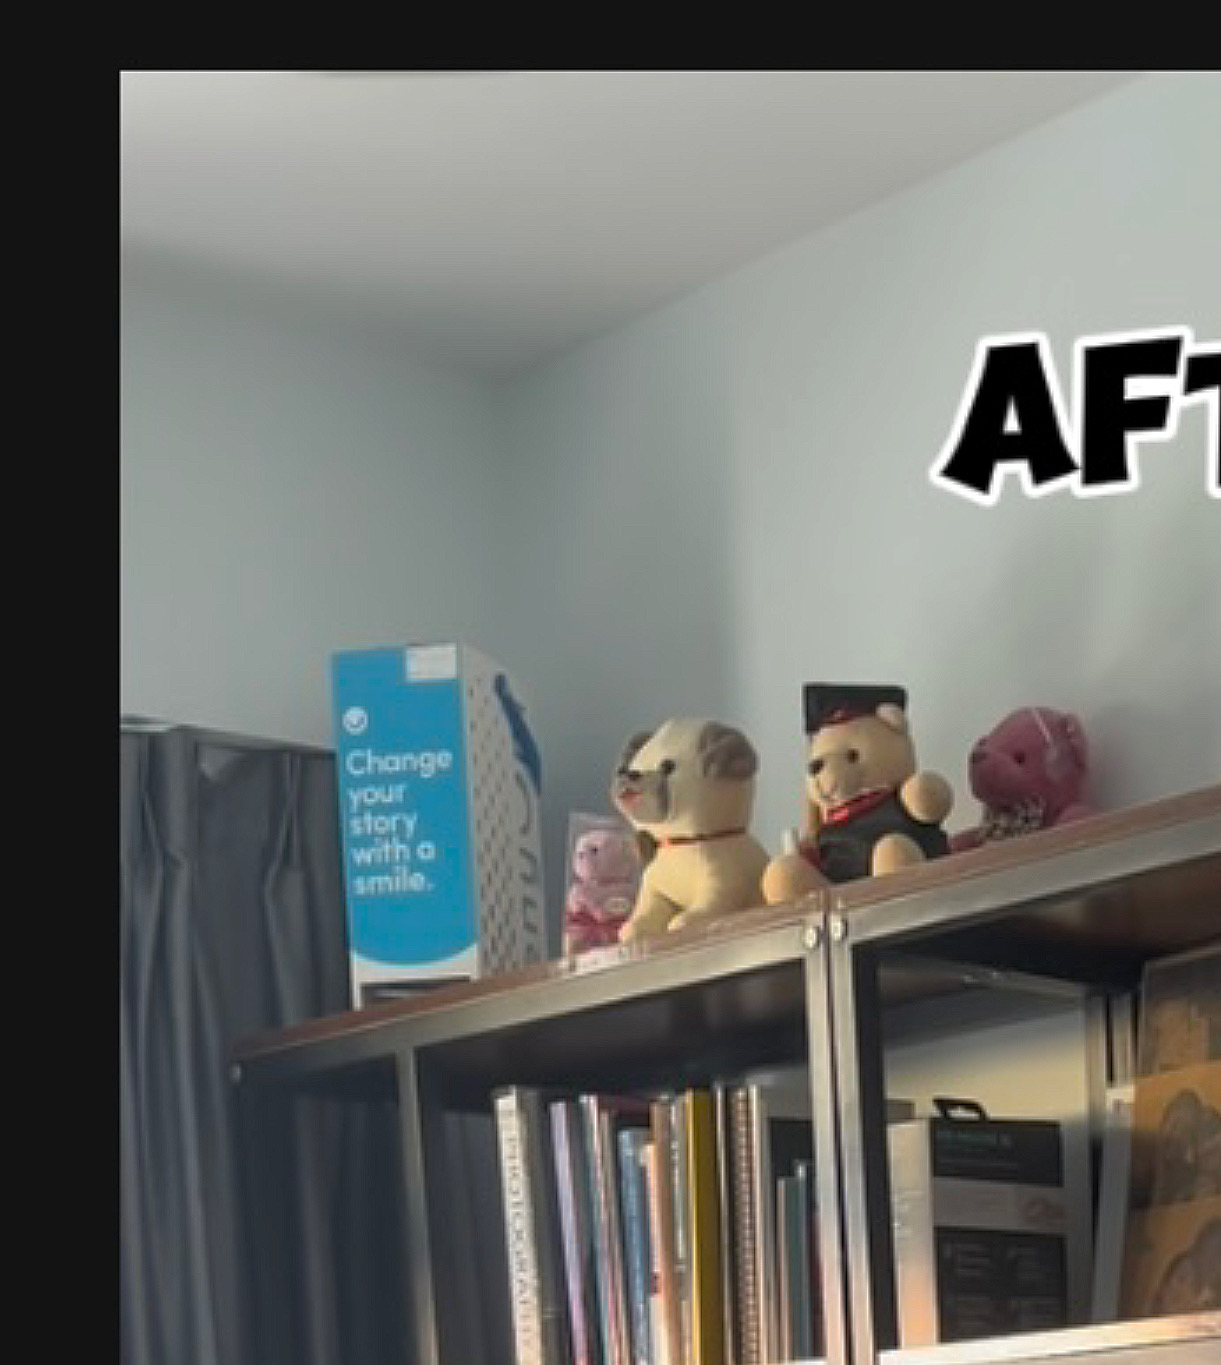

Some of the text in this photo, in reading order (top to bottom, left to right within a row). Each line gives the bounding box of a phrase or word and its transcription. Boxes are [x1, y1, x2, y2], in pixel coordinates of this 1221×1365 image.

[346, 749, 452, 779] Change
[349, 785, 406, 812] your
[350, 812, 418, 838] story
[351, 837, 436, 865] with a
[352, 866, 435, 896] smile.
